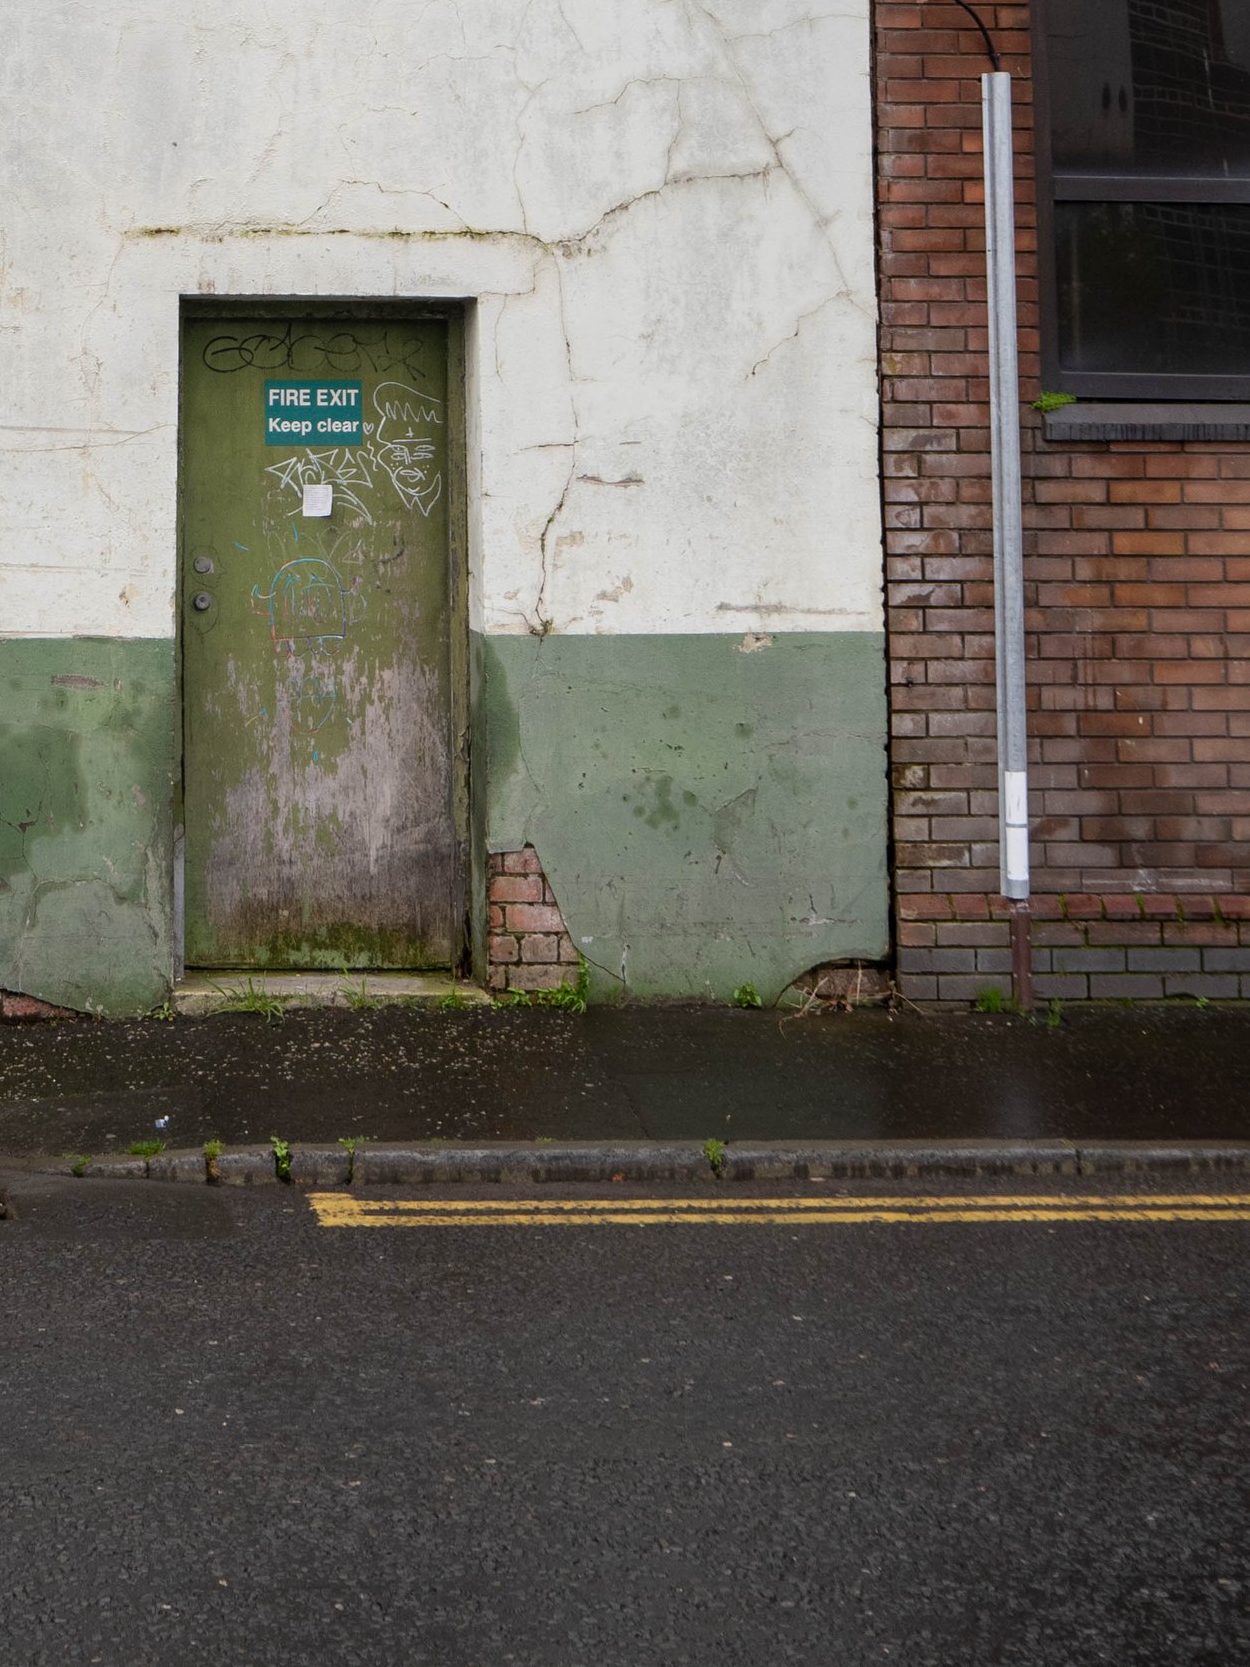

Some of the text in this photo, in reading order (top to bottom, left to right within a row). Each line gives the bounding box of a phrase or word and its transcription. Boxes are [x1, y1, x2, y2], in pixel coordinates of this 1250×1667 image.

[268, 388, 359, 407] FIRE EXIT
[268, 417, 359, 436] Keep clear
